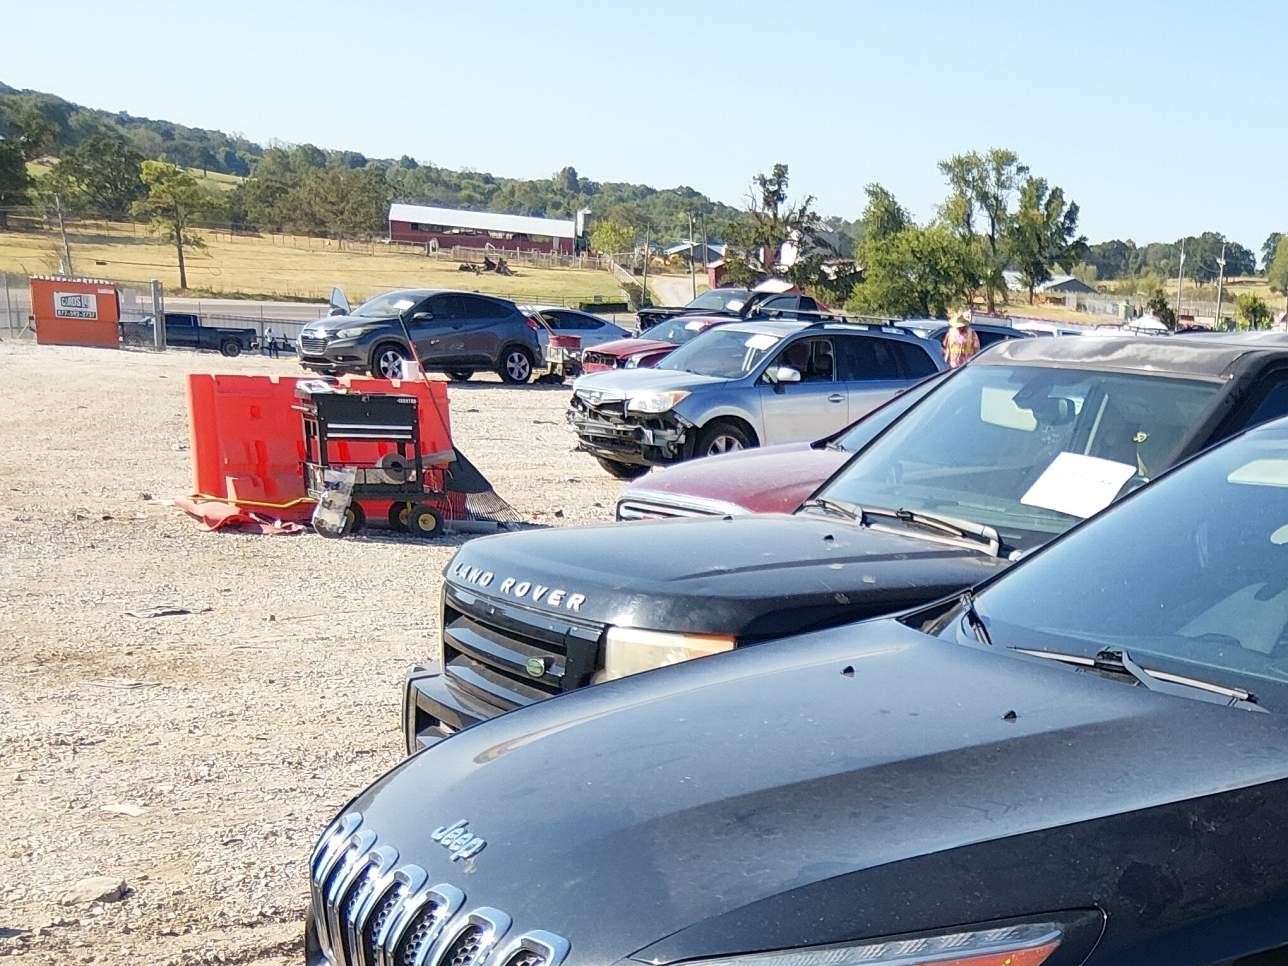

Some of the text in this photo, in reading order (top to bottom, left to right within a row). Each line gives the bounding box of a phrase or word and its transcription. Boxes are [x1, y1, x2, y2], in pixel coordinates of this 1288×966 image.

[455, 563, 586, 612] LAND ROVER
[431, 819, 487, 861] Jeep
